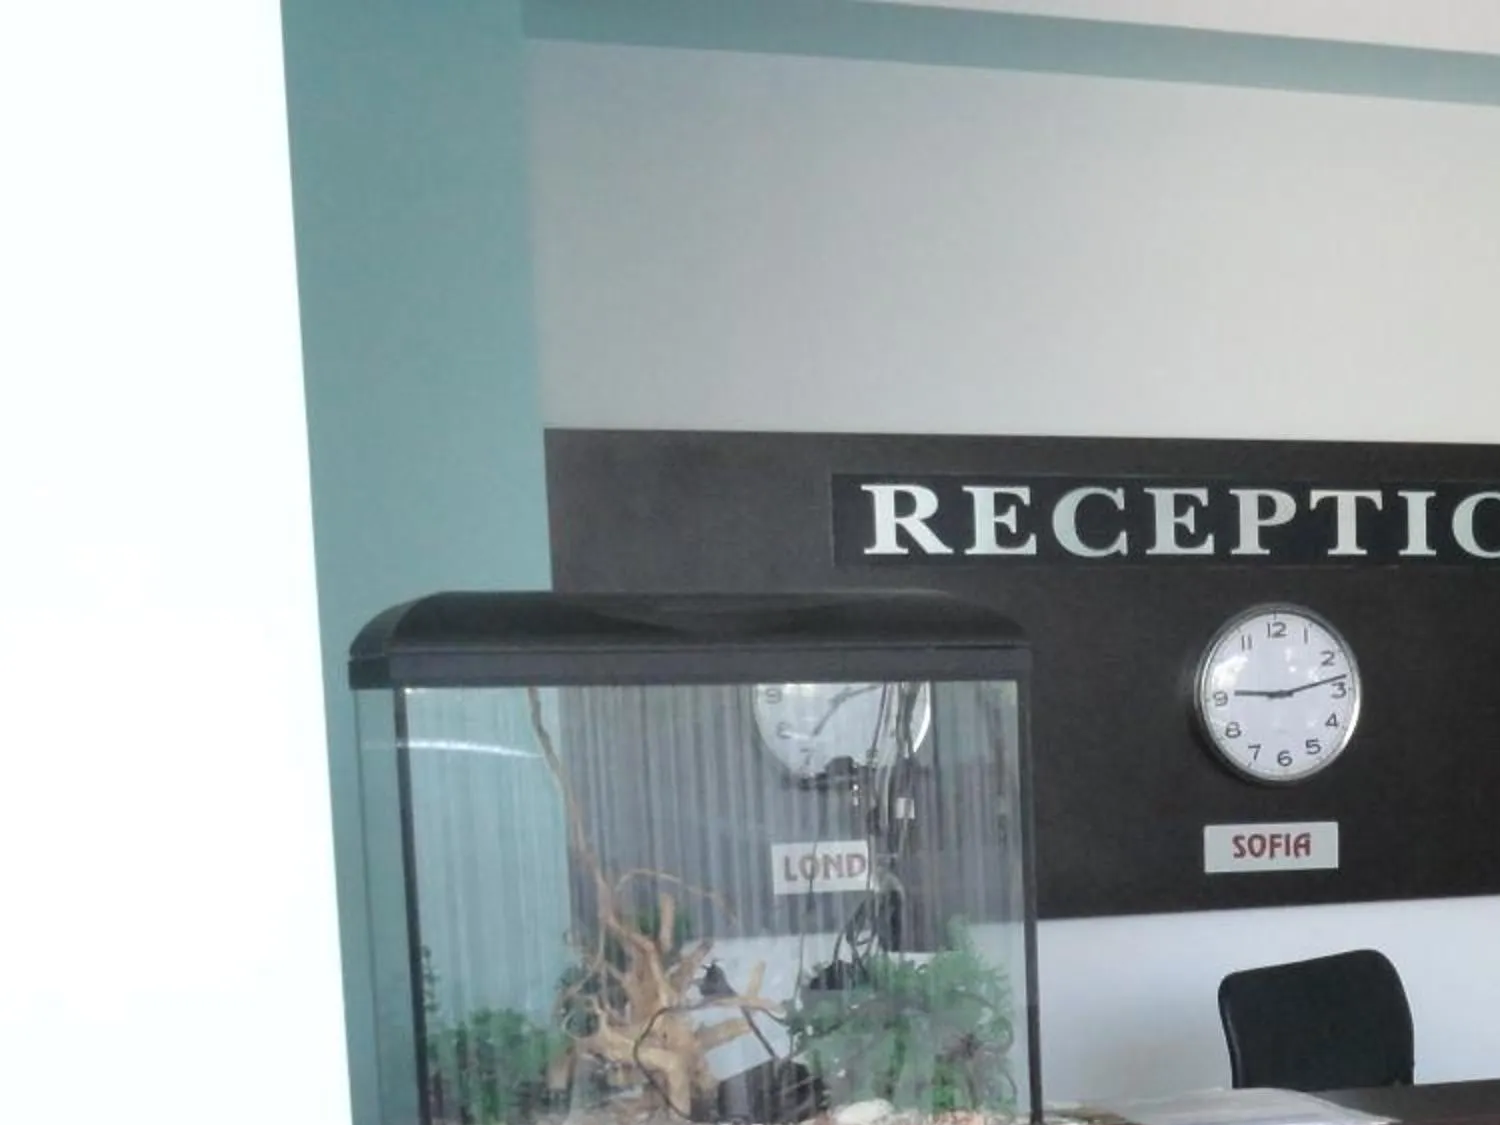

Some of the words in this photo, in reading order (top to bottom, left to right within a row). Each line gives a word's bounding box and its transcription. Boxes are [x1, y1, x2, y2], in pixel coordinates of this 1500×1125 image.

[1266, 621, 1287, 638] 12
[1303, 627, 1309, 645] 1
[1241, 635, 1253, 651] 11
[1320, 650, 1336, 667] 2
[1212, 690, 1229, 707] 9
[1331, 681, 1347, 699] 3
[1325, 712, 1340, 728] 4
[1225, 721, 1242, 738] 8
[1248, 743, 1262, 761] 7
[1305, 738, 1322, 755] 5
[1276, 750, 1293, 767] 6
[1232, 832, 1311, 859] SOFIA
[783, 853, 867, 881] LOND
